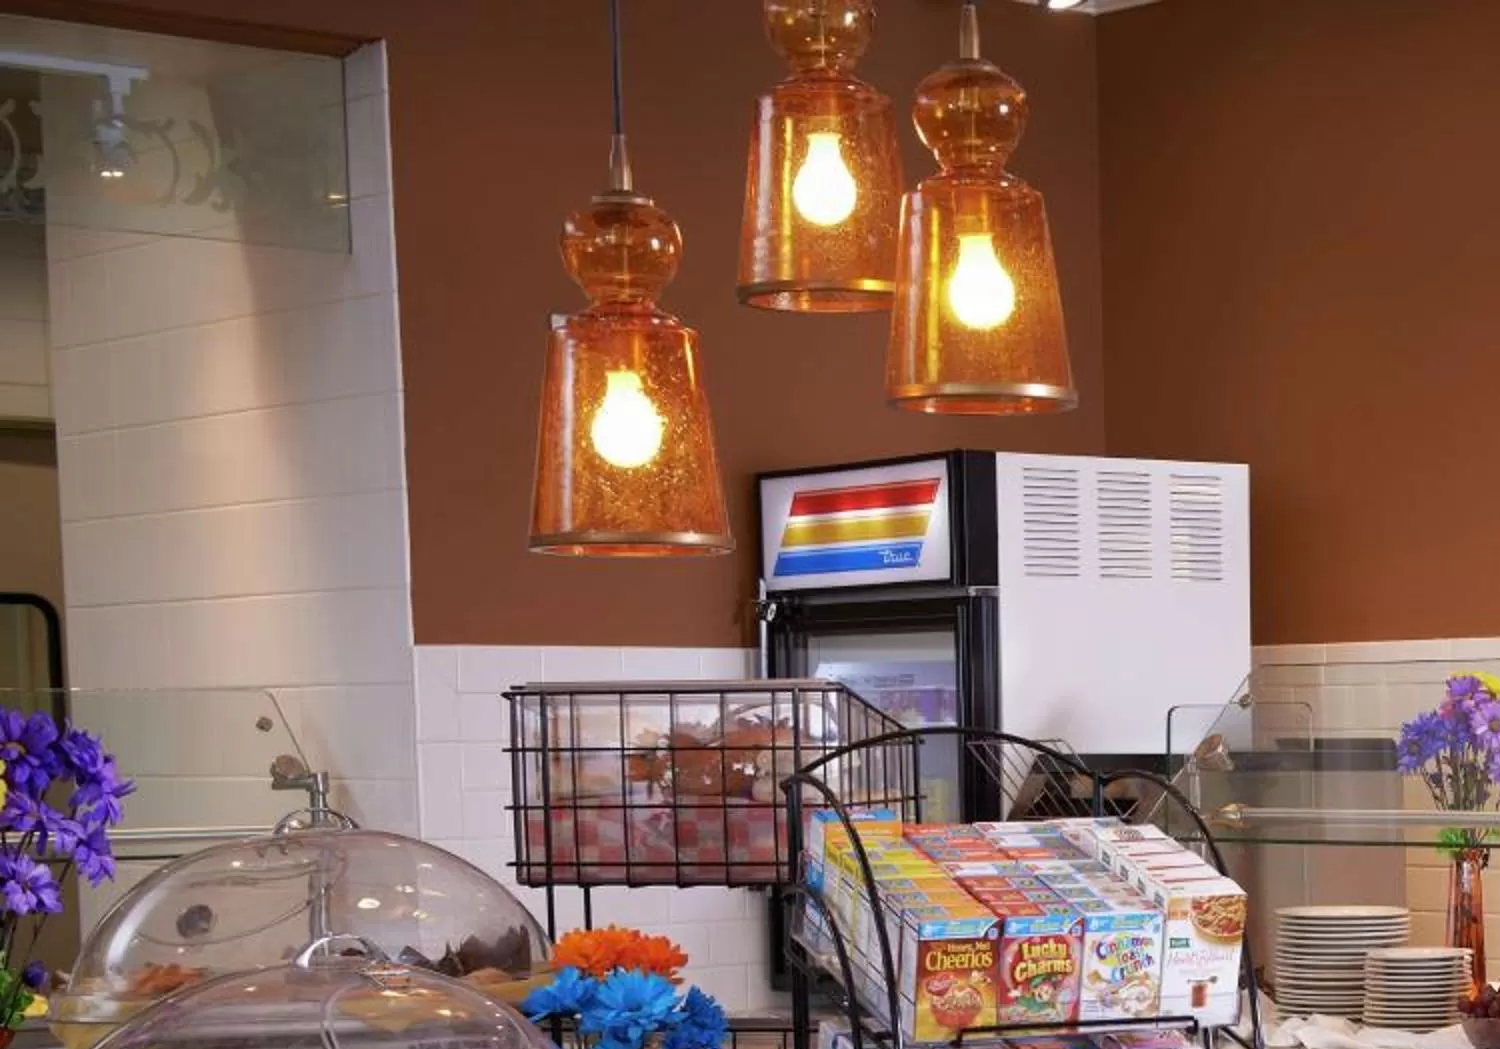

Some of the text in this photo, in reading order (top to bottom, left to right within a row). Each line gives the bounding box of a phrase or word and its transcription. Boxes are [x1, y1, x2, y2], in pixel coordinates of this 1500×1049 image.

[1022, 939, 1067, 960] Lucky
[926, 951, 993, 971] Cheerios
[1015, 959, 1073, 982] Charms
